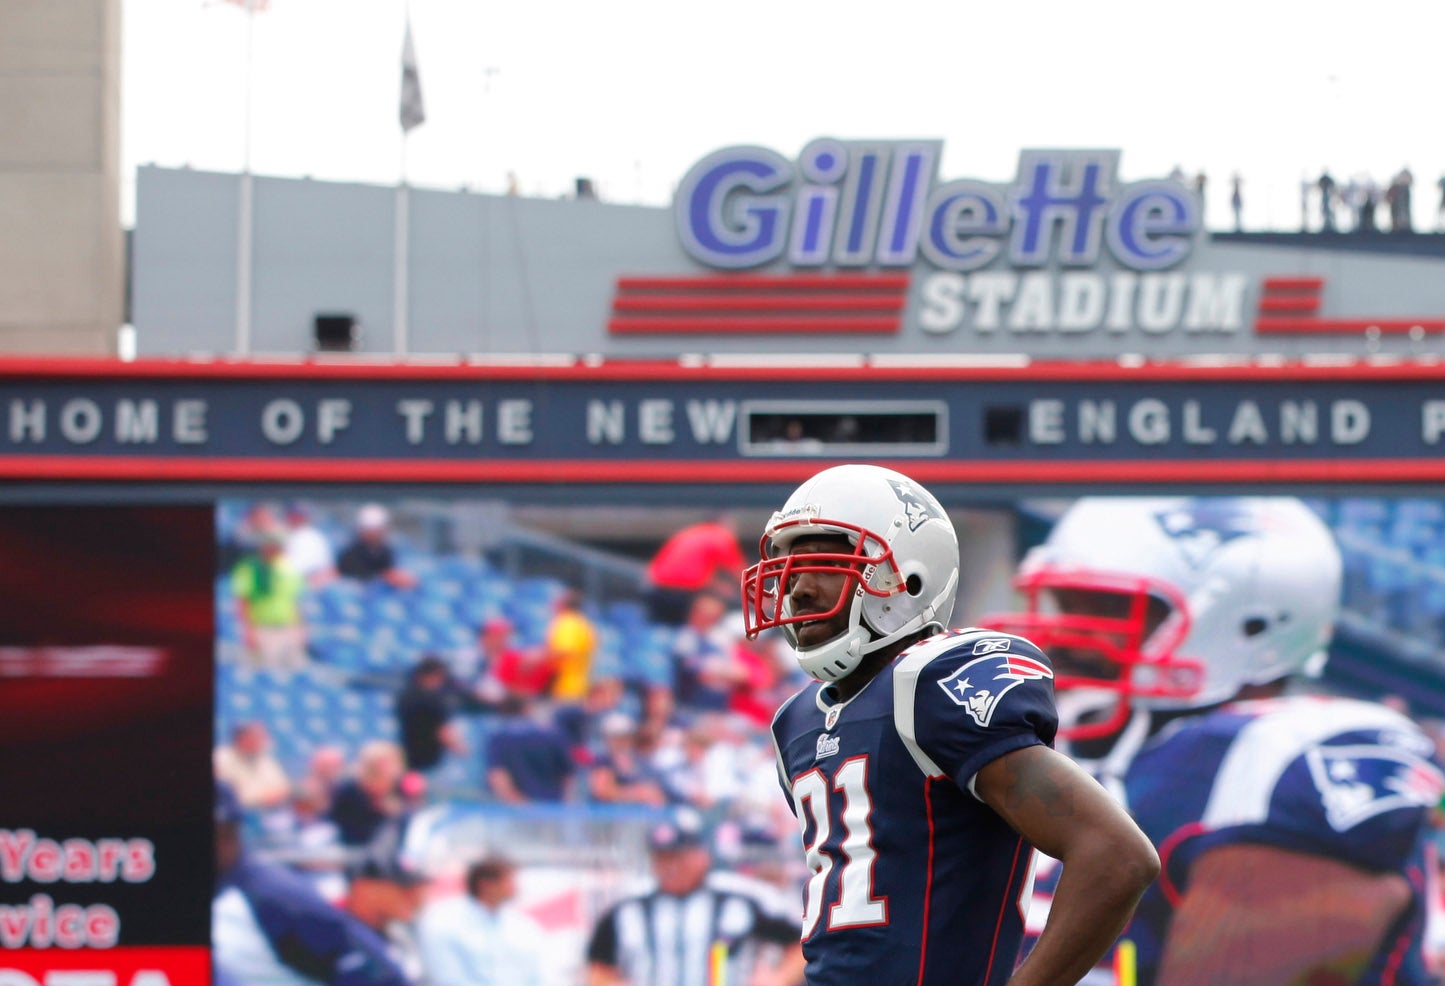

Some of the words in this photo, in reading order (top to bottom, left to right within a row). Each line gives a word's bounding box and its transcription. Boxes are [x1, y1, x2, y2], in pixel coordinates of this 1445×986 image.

[675, 137, 1200, 271] Gillette
[919, 272, 1249, 335] STADIUM
[8, 399, 209, 444] HOME
[261, 399, 352, 444] OF
[397, 399, 534, 444] THE
[586, 399, 737, 444] NEW
[1028, 399, 1372, 444] ENGLAND
[0, 828, 156, 884] Years
[791, 754, 890, 943] 81
